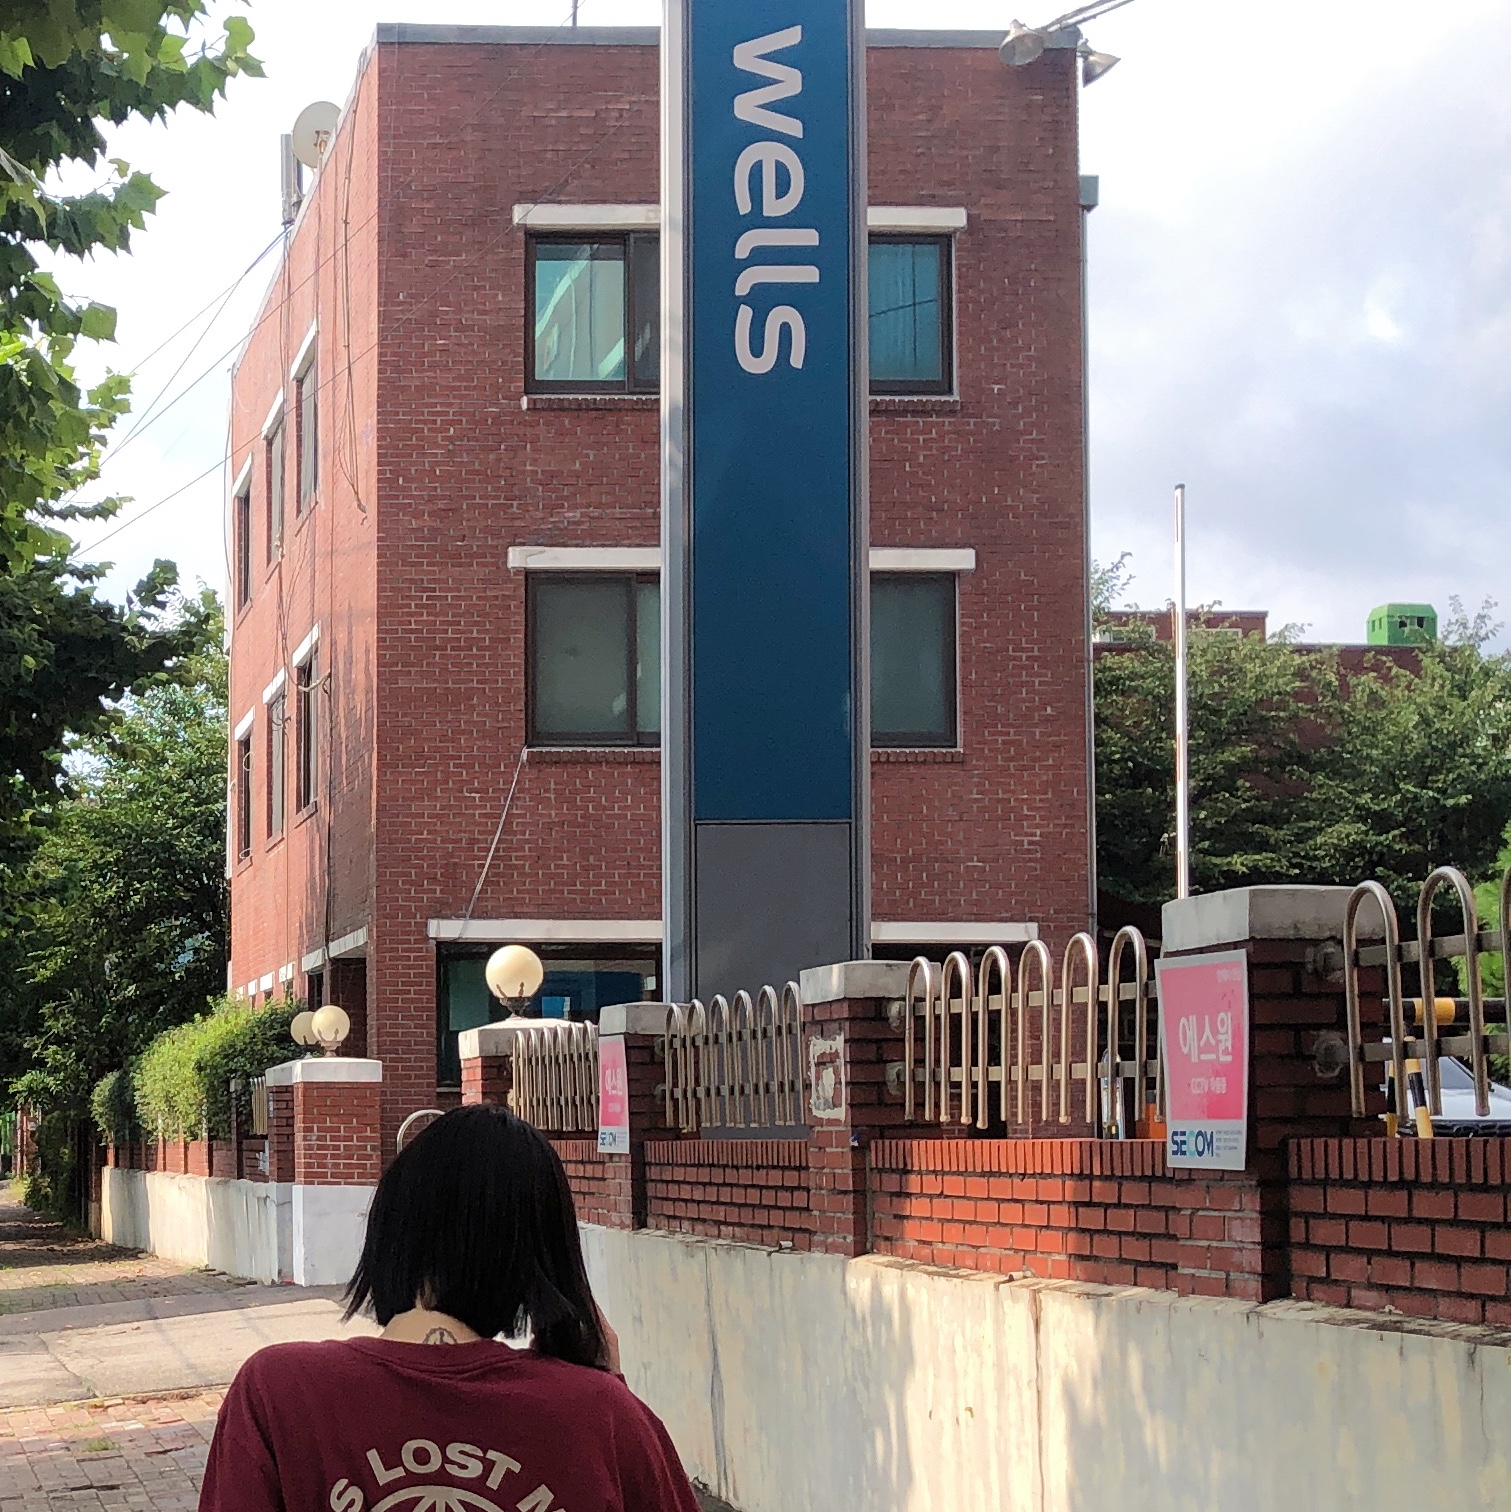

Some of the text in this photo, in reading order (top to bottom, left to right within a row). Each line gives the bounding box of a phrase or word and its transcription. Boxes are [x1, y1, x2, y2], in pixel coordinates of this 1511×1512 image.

[734, 25, 820, 374] wells
[1178, 1012, 1233, 1062] 에스원
[1171, 1130, 1214, 1157] SECOM
[366, 1438, 522, 1491] LOST
